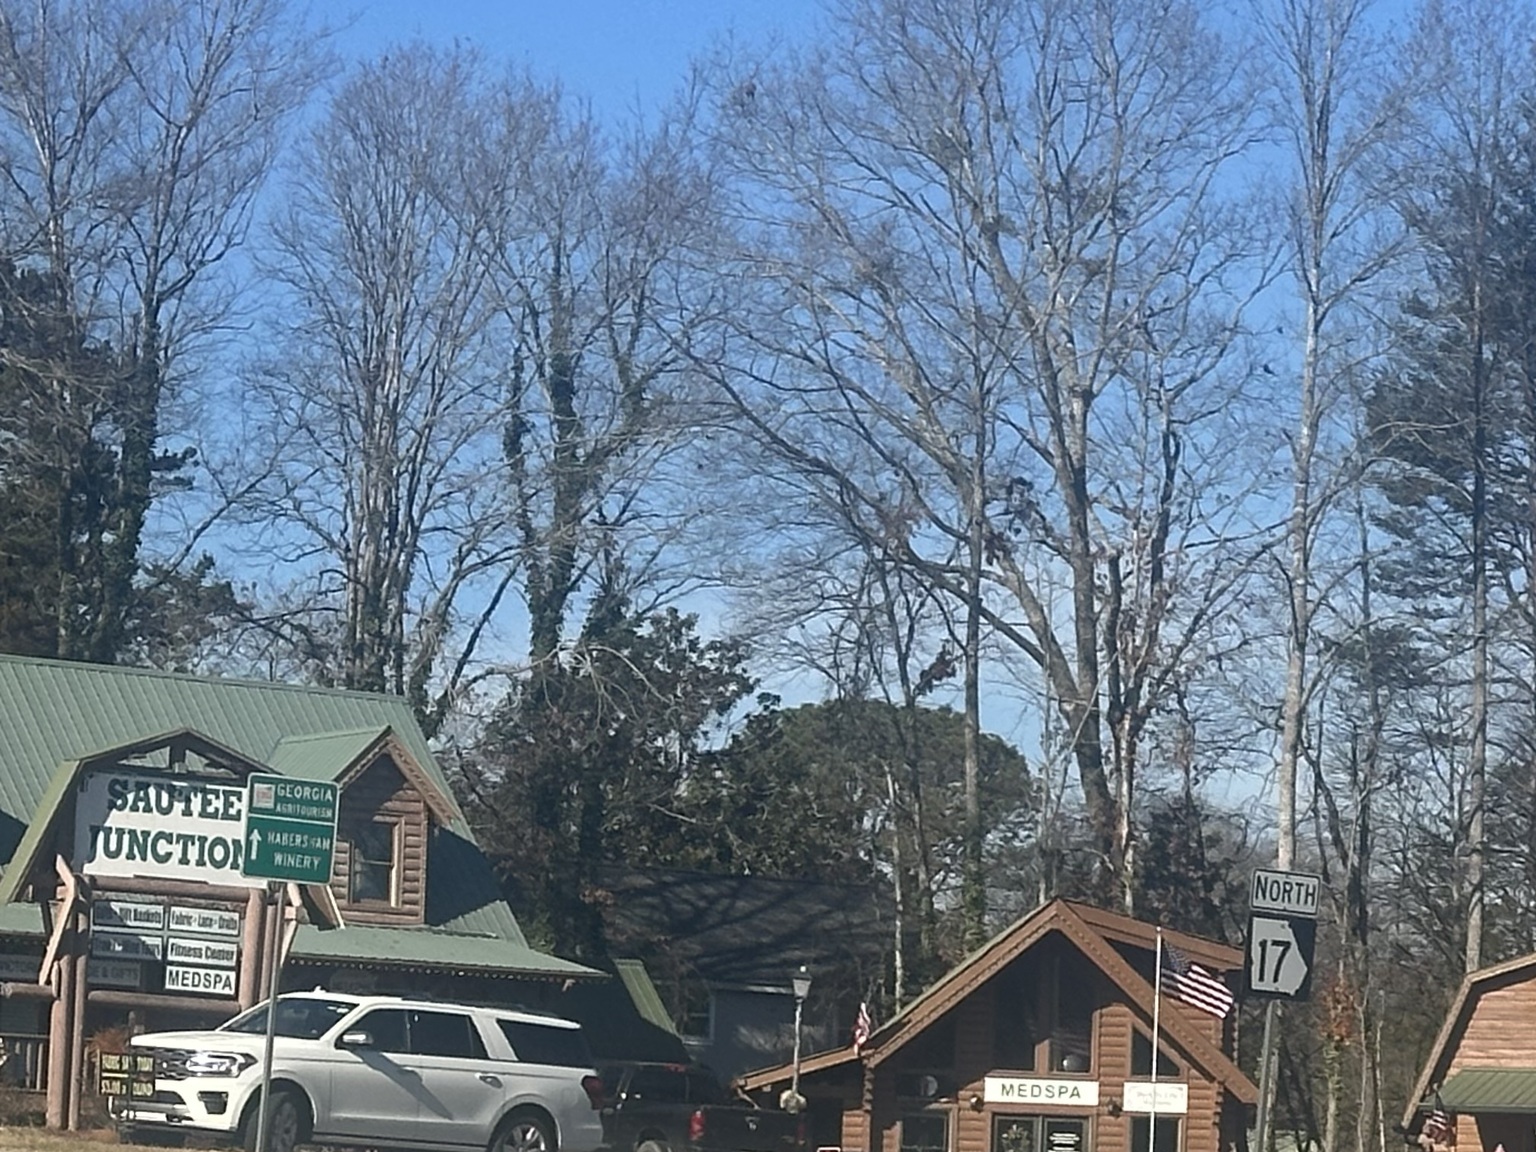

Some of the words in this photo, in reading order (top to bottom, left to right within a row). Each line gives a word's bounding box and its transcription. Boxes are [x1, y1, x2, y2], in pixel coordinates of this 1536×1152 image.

[108, 778, 242, 821] SAUTEE
[276, 783, 333, 803] GEORGIA
[275, 802, 333, 819] AGRITOURISM
[273, 851, 322, 872] WINERY
[1254, 875, 1317, 907] NORTH
[204, 943, 236, 962] Center
[1258, 939, 1292, 984] 17
[168, 969, 233, 991] MEDSPA
[1001, 1083, 1081, 1099] MEDSPA
